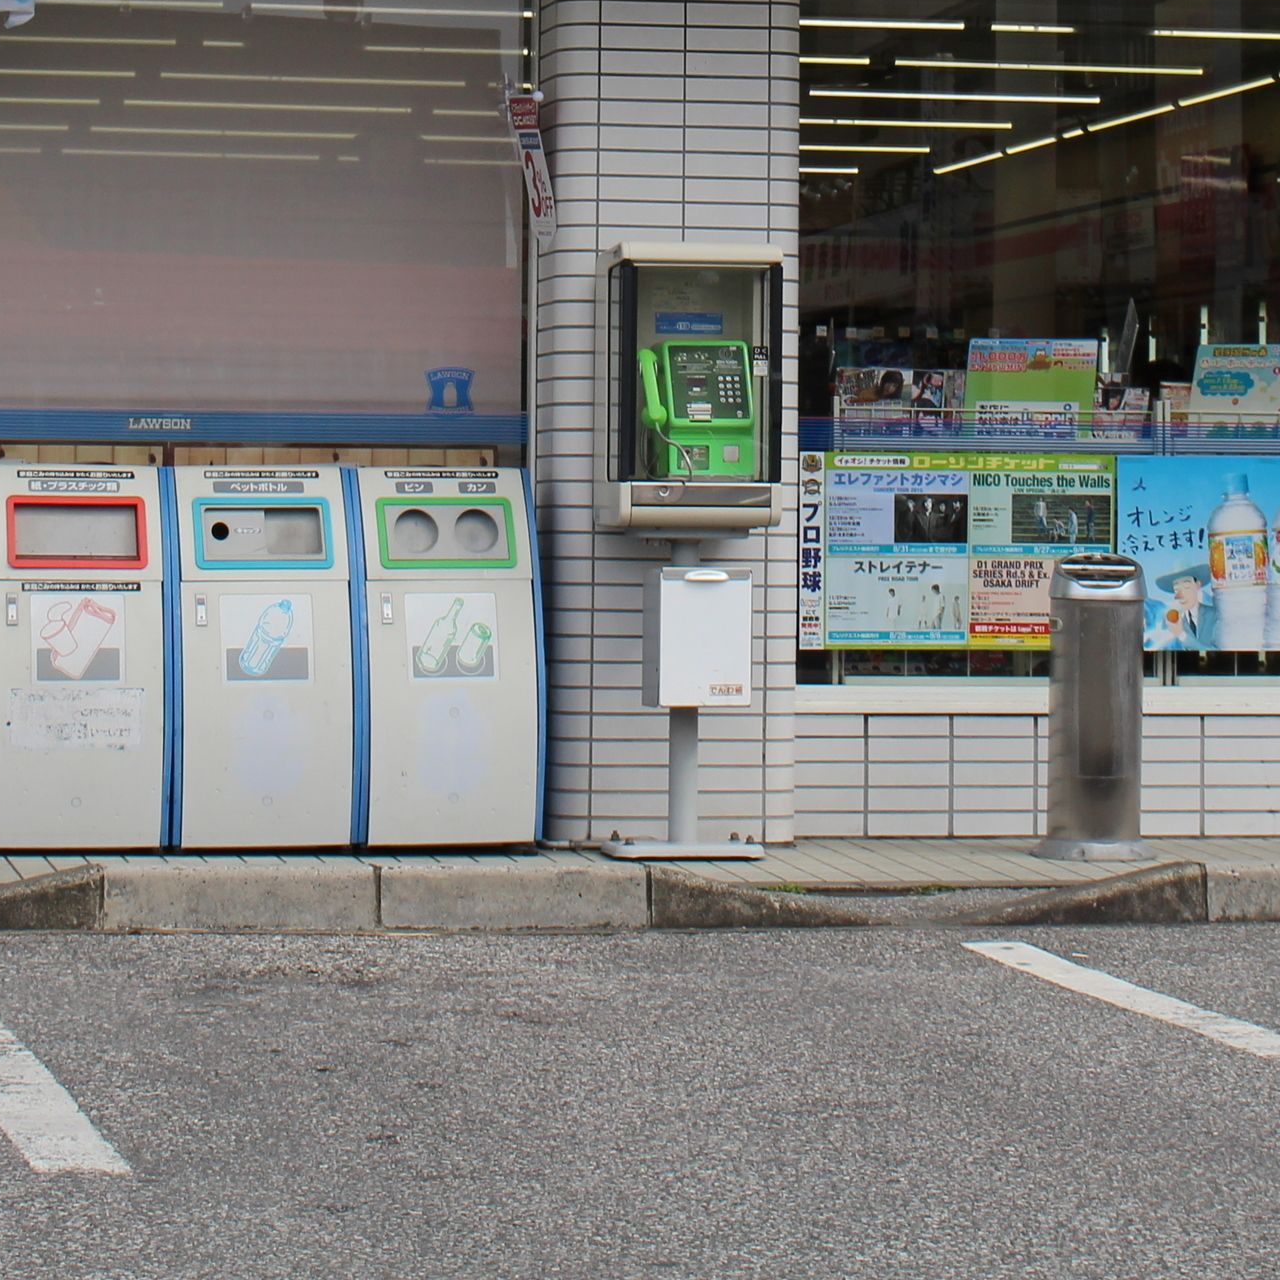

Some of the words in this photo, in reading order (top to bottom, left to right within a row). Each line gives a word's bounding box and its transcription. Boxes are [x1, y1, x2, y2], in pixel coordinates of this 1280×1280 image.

[129, 417, 192, 430] LAWSON
[913, 456, 1055, 469] ローソンチケット
[834, 472, 963, 487] エレファントカシマシ
[973, 473, 1001, 487] NICO
[1004, 473, 1053, 488] Touches
[1056, 473, 1075, 488] the
[1078, 474, 1111, 489] Walls
[30, 481, 118, 492] 紙・プラスチック類
[231, 482, 287, 492] ペットボトル
[404, 482, 424, 492] ビン
[466, 482, 487, 492] カン
[1127, 505, 1193, 528] オレンジ
[802, 500, 823, 593] プロ野球
[1122, 528, 1205, 555] 冷えてます!
[853, 560, 943, 574] ストレイテナー
[976, 560, 988, 570] D1
[991, 560, 1021, 570] GRAND
[1024, 560, 1044, 570] PRIX
[973, 569, 1003, 579] SERIES
[1006, 569, 1026, 579] Rd.5
[1028, 569, 1035, 579] &
[1037, 569, 1051, 579] Ex.
[983, 579, 1012, 589] OSAKA
[1015, 579, 1039, 589] DRIFT
